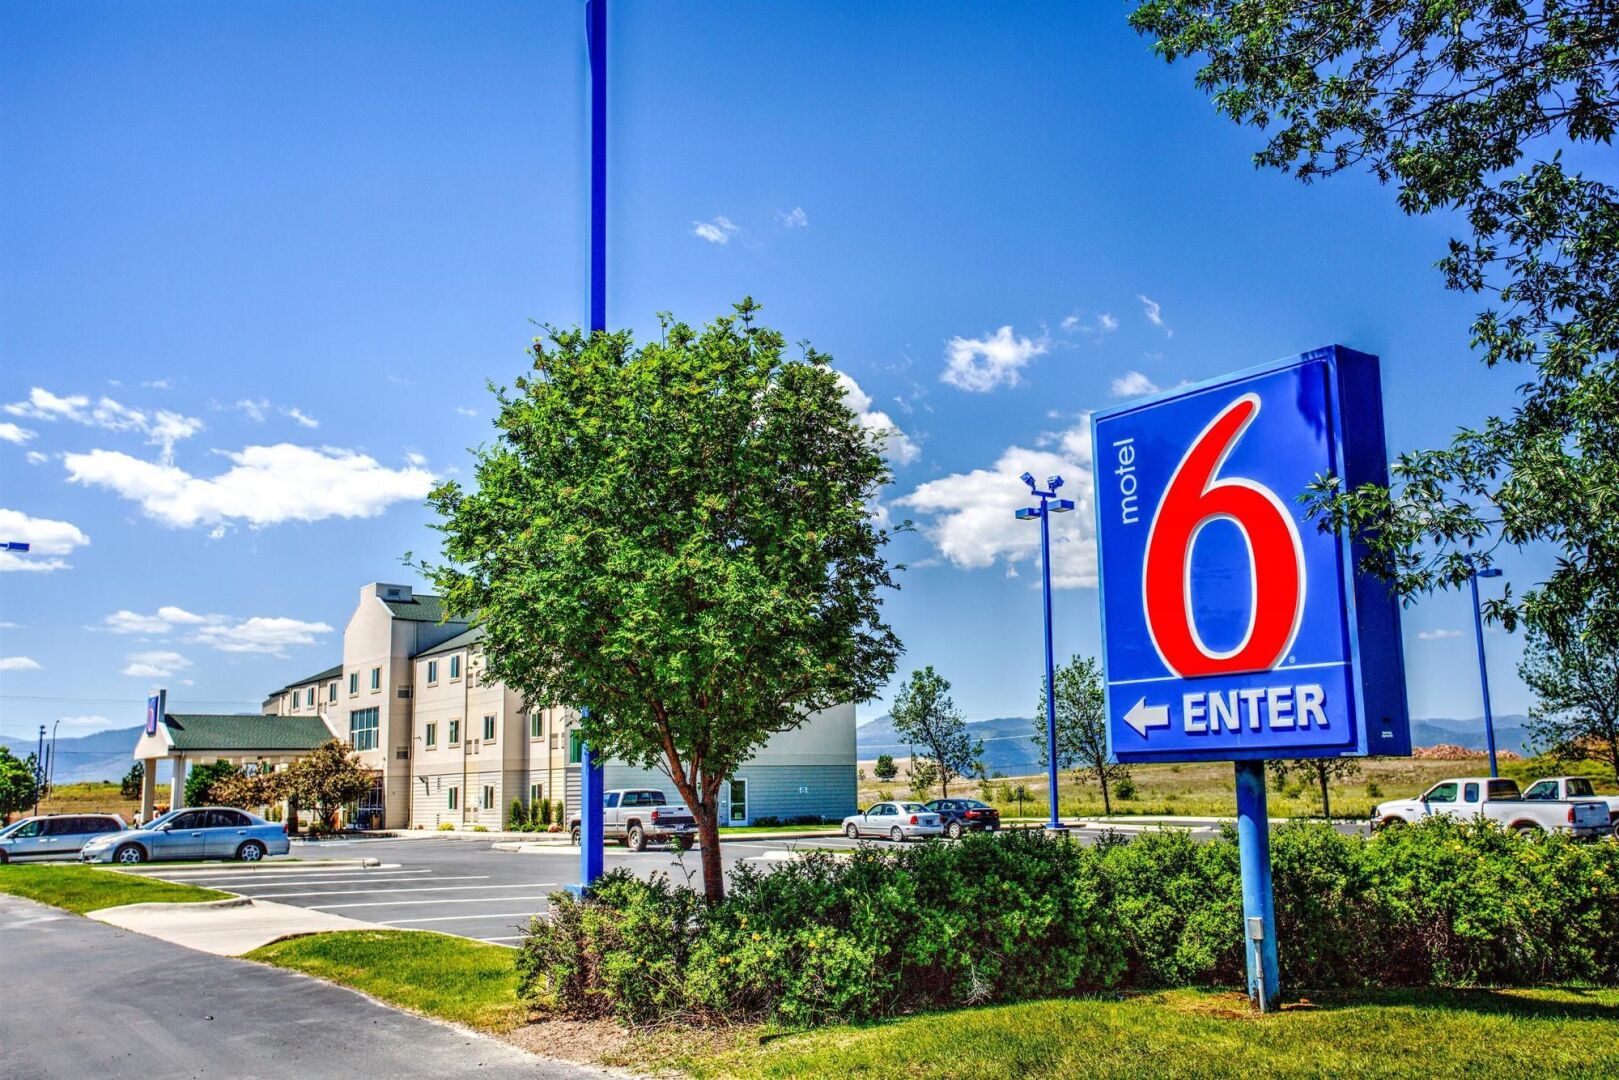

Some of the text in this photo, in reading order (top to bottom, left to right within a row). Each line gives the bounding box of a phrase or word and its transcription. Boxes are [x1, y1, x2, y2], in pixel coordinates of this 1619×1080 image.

[1113, 392, 1307, 680] motel 6
[1183, 684, 1328, 732] ENTER
